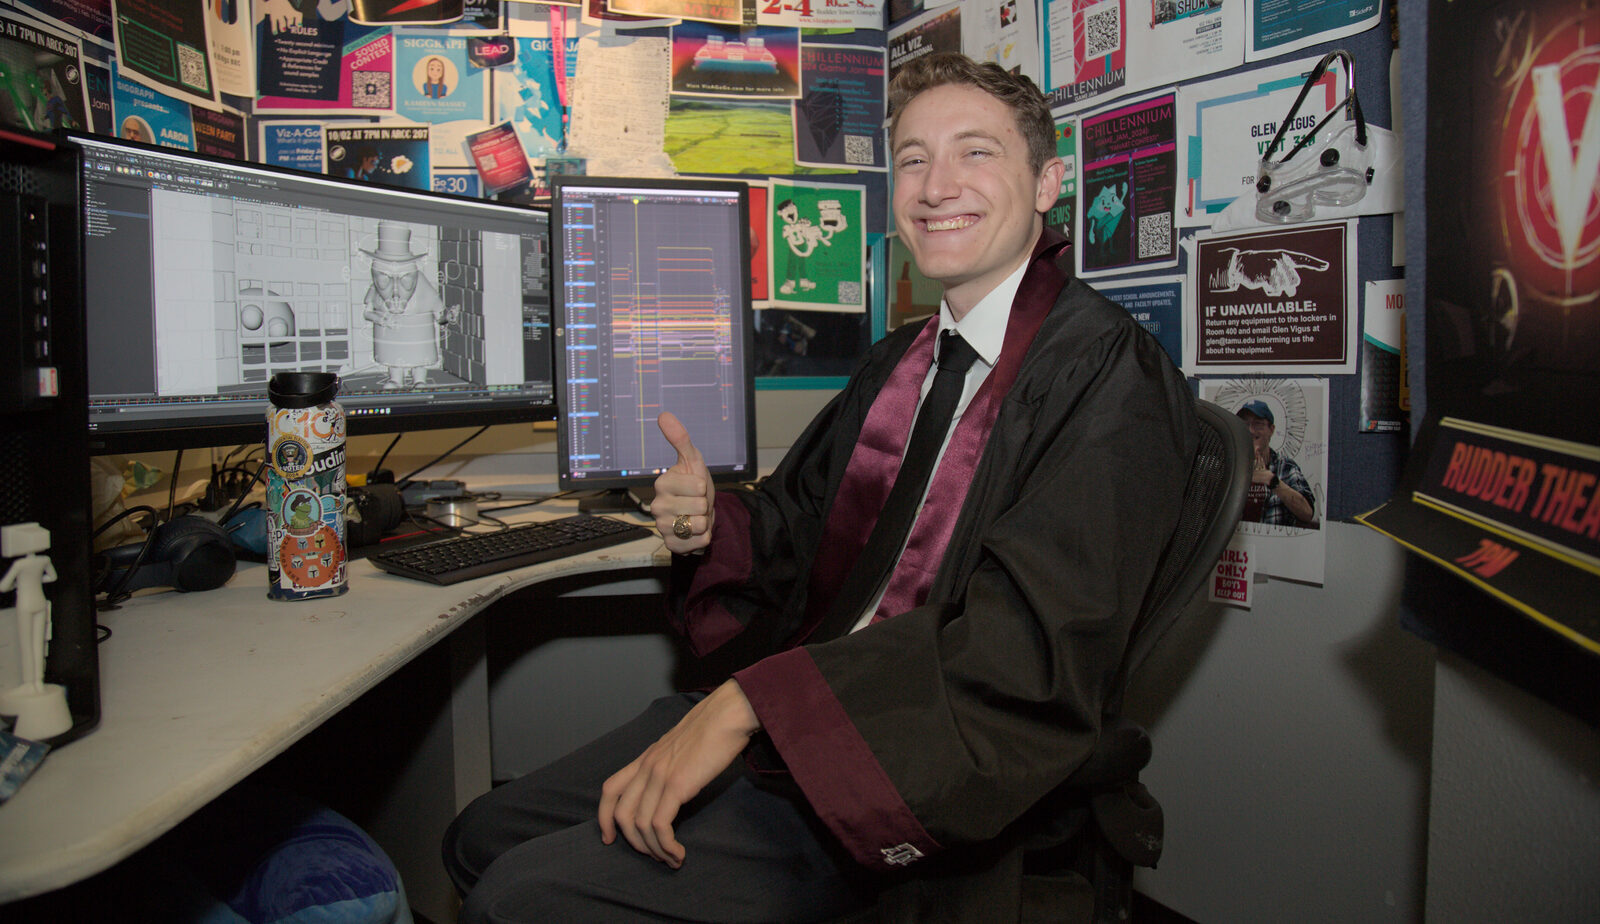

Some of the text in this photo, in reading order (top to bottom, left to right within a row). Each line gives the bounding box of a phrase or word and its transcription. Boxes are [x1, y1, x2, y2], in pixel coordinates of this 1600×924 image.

[290, 26, 319, 37] RULES
[7, 23, 18, 36] AT
[20, 27, 37, 43] 7PM
[37, 32, 46, 47] IN
[46, 36, 64, 54] ARCC
[65, 43, 78, 58] 207
[891, 36, 923, 60] ALL VIZ
[355, 38, 389, 59] SOUND
[475, 45, 510, 56] LEAD
[350, 46, 392, 70] CONTEST
[1086, 106, 1172, 140] CHILLENNIUM
[1251, 115, 1317, 138] GLEN IGUS
[160, 128, 189, 144] AARON
[328, 129, 428, 142] 10/02 AT 7PM IN ARCC 207
[447, 177, 468, 193] 30
[1241, 176, 1255, 185] FOR
[1205, 301, 1317, 317] IF UNAVAILABLE:
[1206, 319, 1226, 327] Return
[1228, 319, 1239, 328] any
[1241, 316, 1277, 328] equipment
[1287, 315, 1298, 323] the
[1300, 313, 1328, 322] lockers
[1206, 323, 1320, 337] Room 400 and email Glen Vigus at
[1206, 337, 1255, 347] glen@tamu.edu
[1256, 335, 1290, 345] informing
[1303, 334, 1314, 342] the
[1206, 346, 1224, 354] about
[1237, 345, 1274, 355] equipment.
[1442, 442, 1538, 513] RUDDER
[1217, 564, 1248, 578] ONLY
[1222, 580, 1241, 590] BOYS
[1232, 591, 1246, 600] OUT
